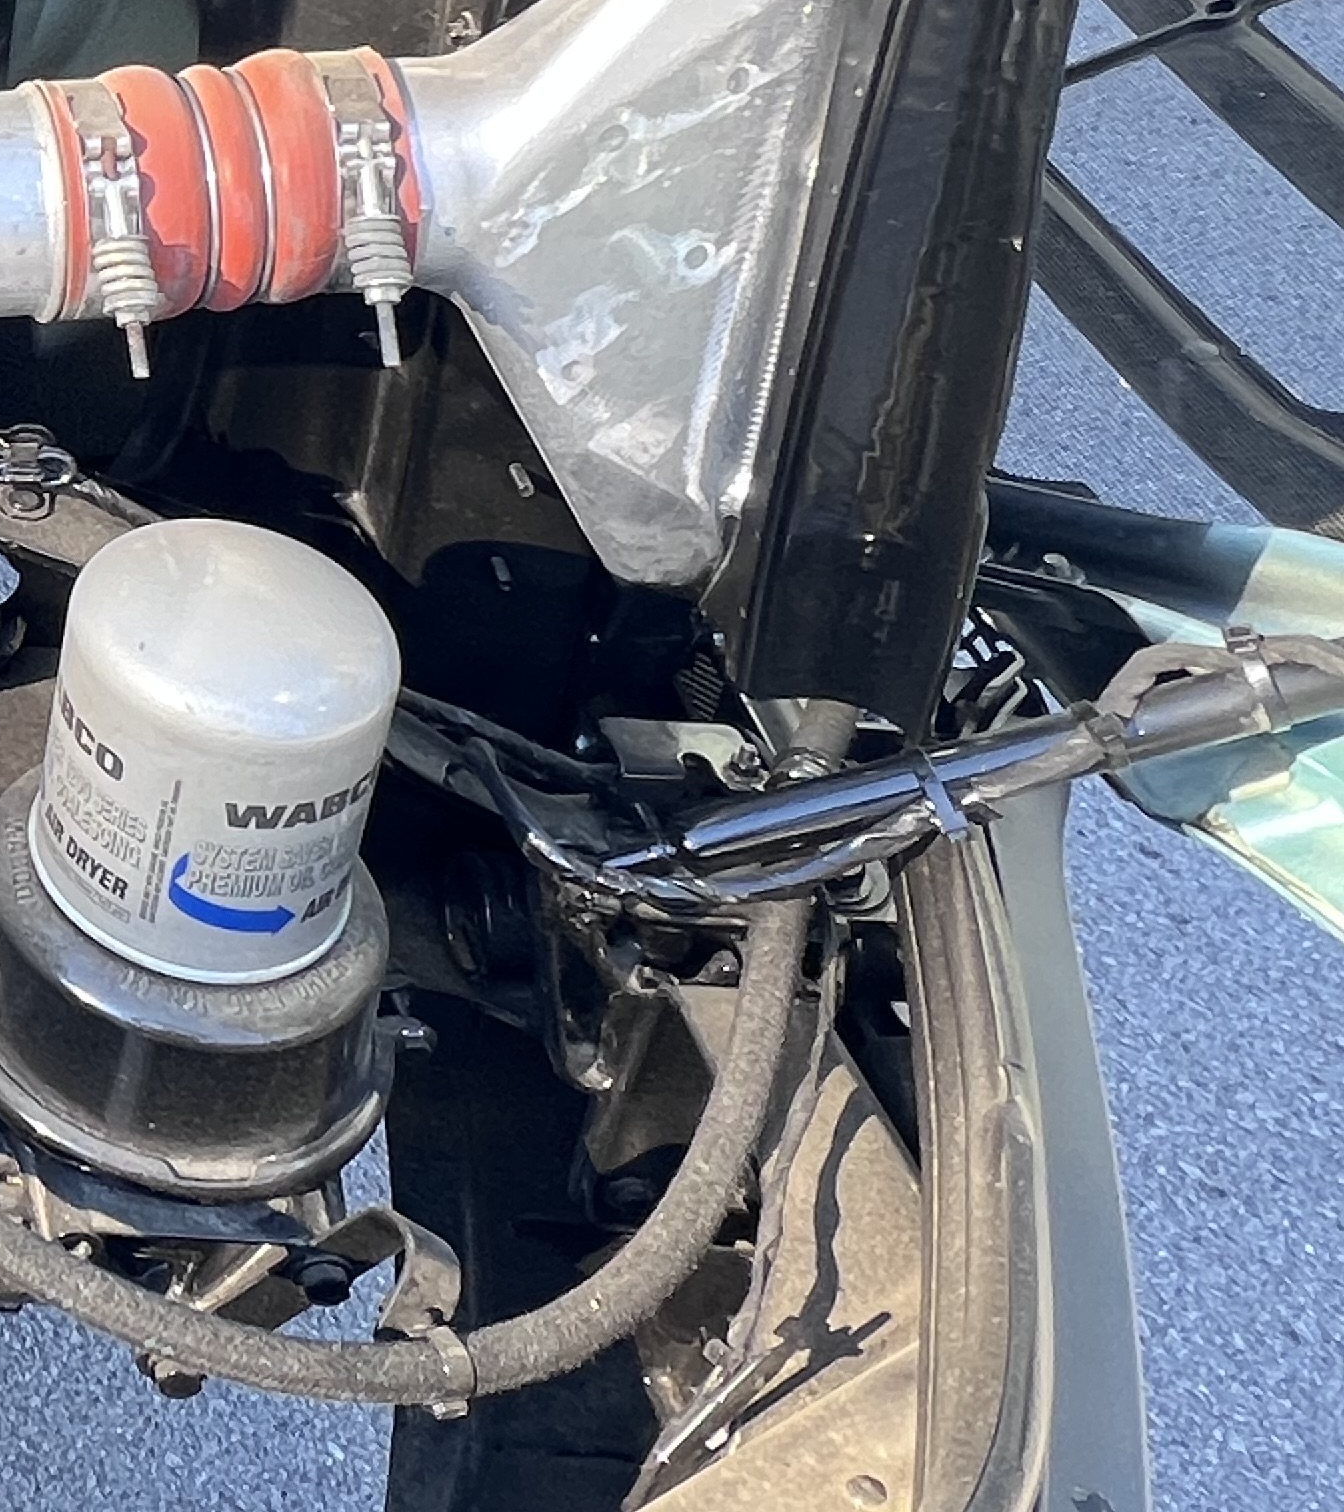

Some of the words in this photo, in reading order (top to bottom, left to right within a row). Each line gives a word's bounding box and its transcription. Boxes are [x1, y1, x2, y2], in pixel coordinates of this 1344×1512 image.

[60, 690, 124, 782] BCO
[224, 758, 380, 830] WABC
[66, 834, 129, 901] DRYER
[188, 870, 285, 898] PREMIUM
[193, 840, 277, 873] SYSTEM
